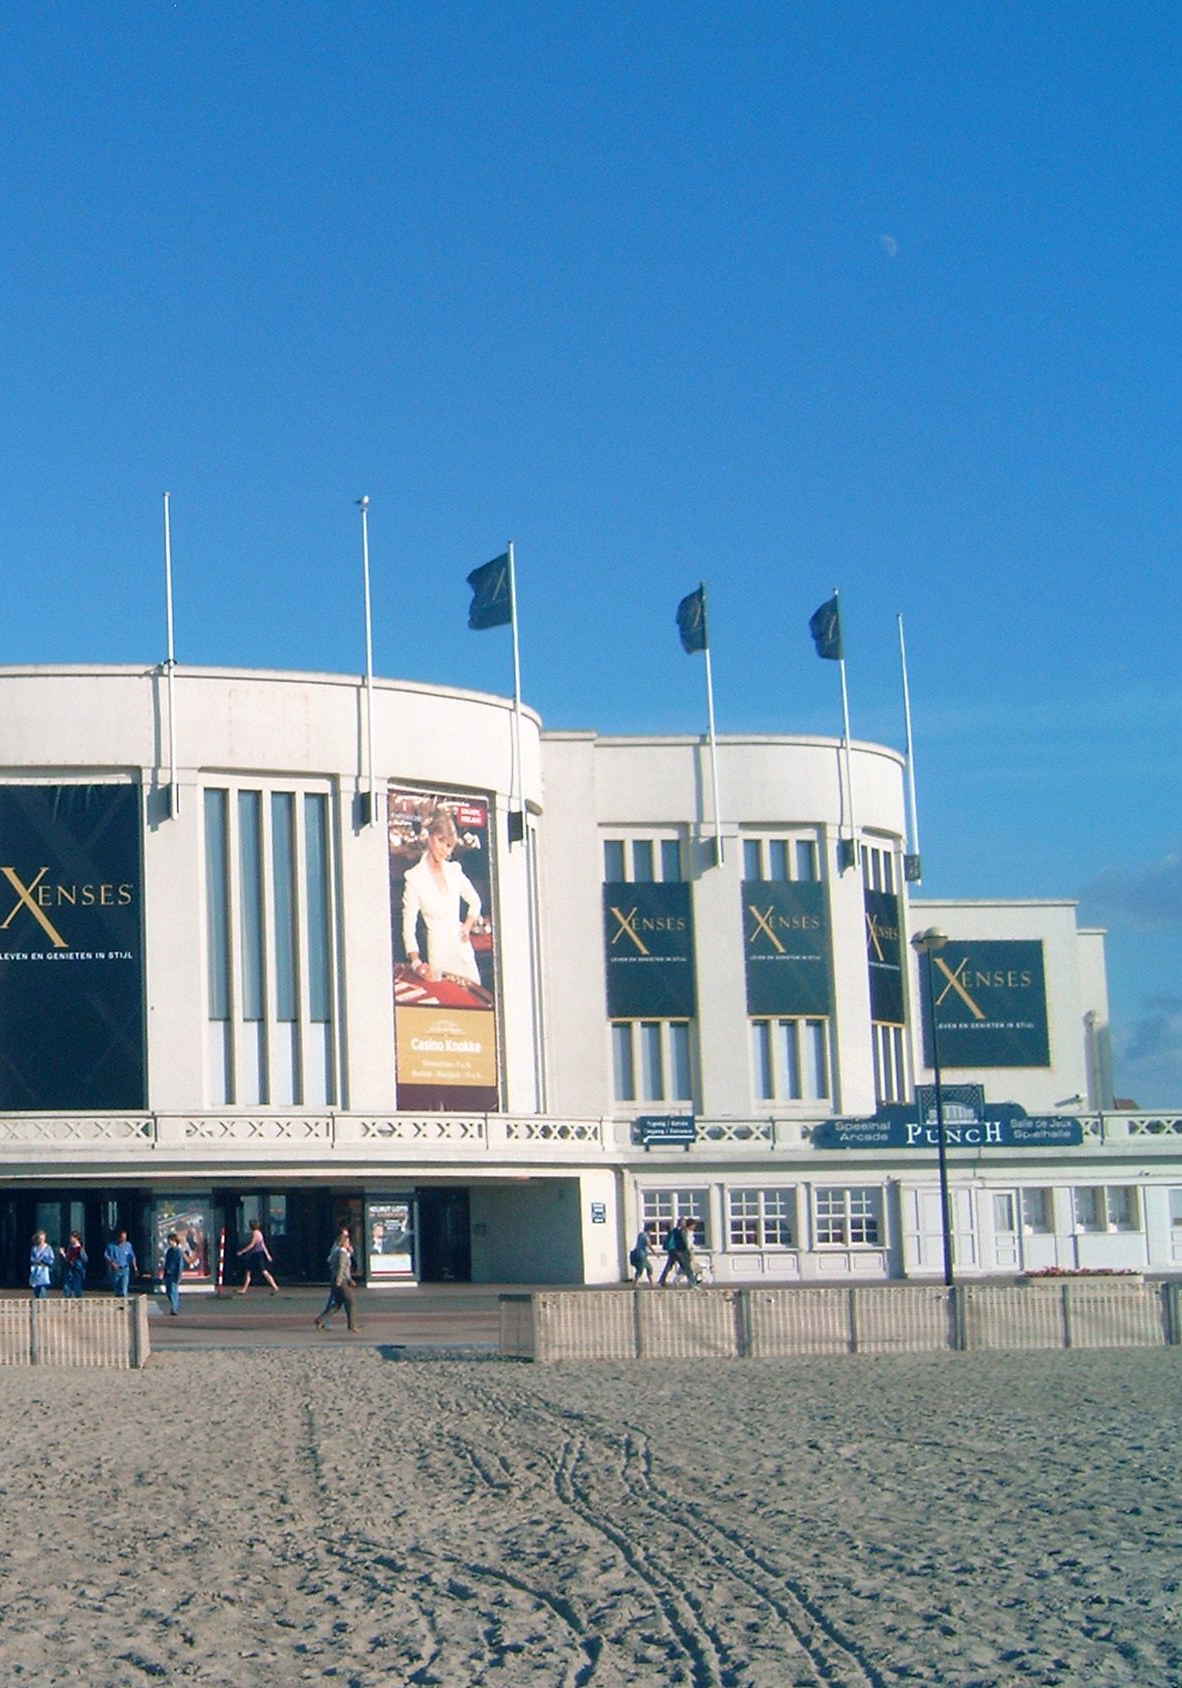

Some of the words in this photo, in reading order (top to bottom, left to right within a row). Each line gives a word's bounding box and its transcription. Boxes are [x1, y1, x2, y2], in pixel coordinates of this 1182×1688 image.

[0, 866, 132, 948] XENSES
[610, 906, 686, 955] XENSES
[748, 905, 820, 954] XENSES
[31, 951, 44, 961] EN
[46, 951, 93, 961] GENIETEN
[95, 951, 105, 961] IN
[108, 951, 133, 961] STIJL
[934, 957, 1032, 1020] XENSES
[410, 1038, 444, 1052] Casino
[445, 1039, 482, 1053] Knokke
[839, 1132, 889, 1141] Arcade
[905, 1121, 1002, 1144] PUNCH
